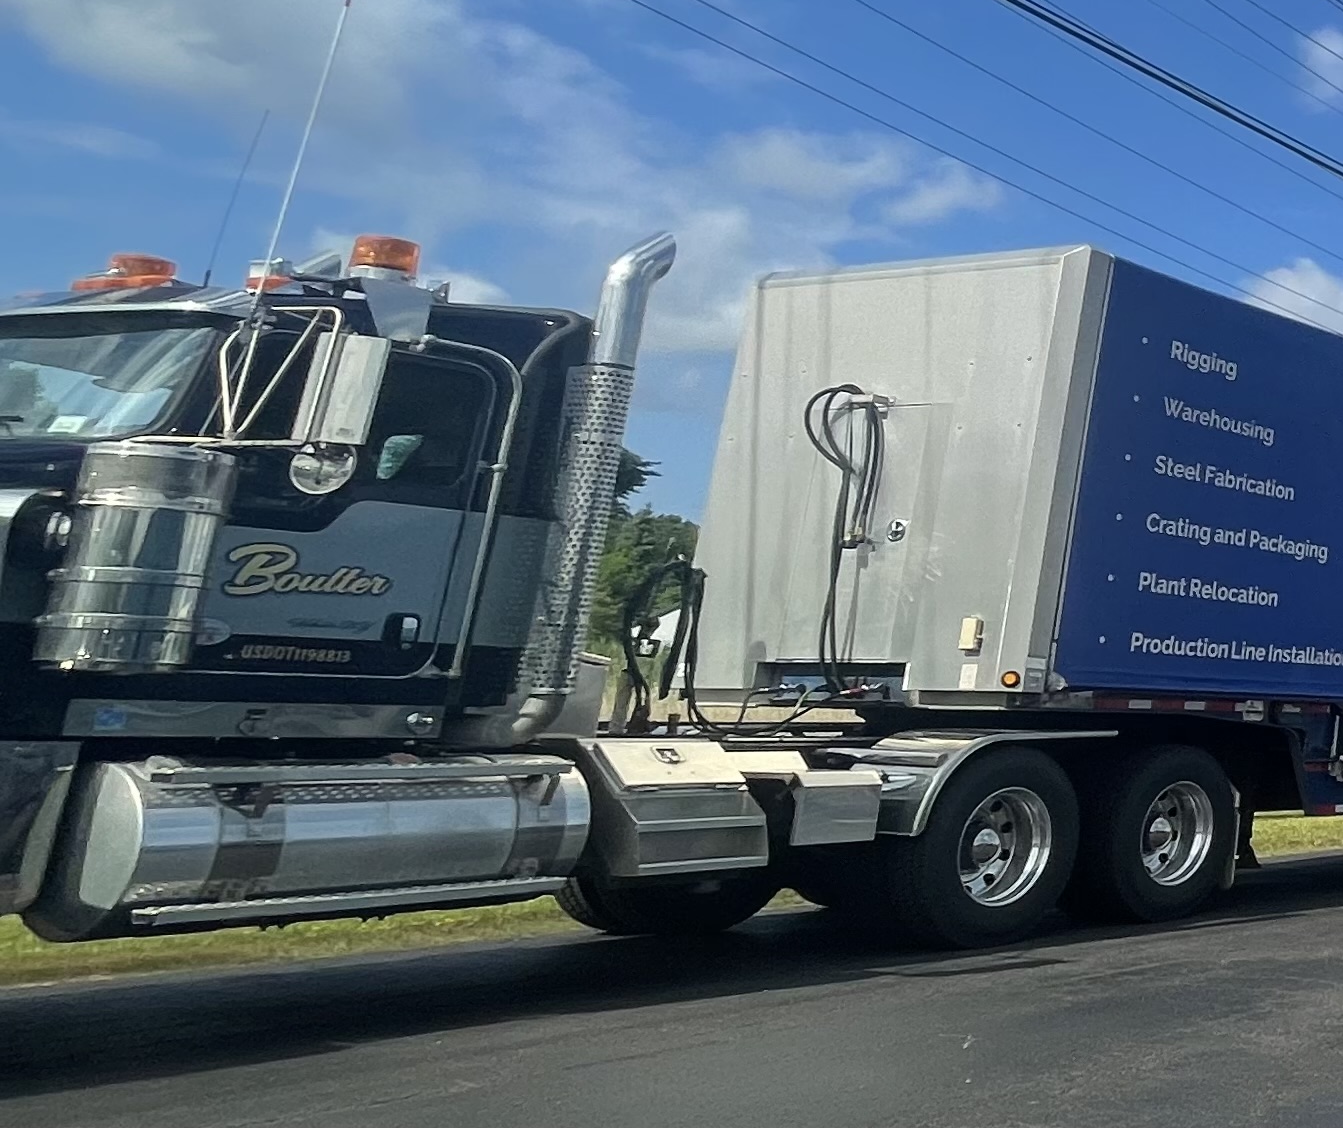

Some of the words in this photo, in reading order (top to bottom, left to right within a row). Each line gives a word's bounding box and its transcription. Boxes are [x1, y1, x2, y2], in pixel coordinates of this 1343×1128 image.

[1170, 340, 1238, 381] Rigging
[1163, 396, 1276, 447] Warehousing
[1154, 455, 1201, 482] Steel
[1204, 465, 1296, 501] Fabrication
[1146, 513, 1211, 546] Crating
[1213, 527, 1246, 547] and
[1249, 530, 1329, 564] Packaging
[223, 542, 394, 597] Boulter
[1138, 571, 1187, 597] Plant
[1189, 578, 1280, 608] Relocation
[1130, 632, 1229, 660] Production
[1231, 641, 1267, 662] Line
